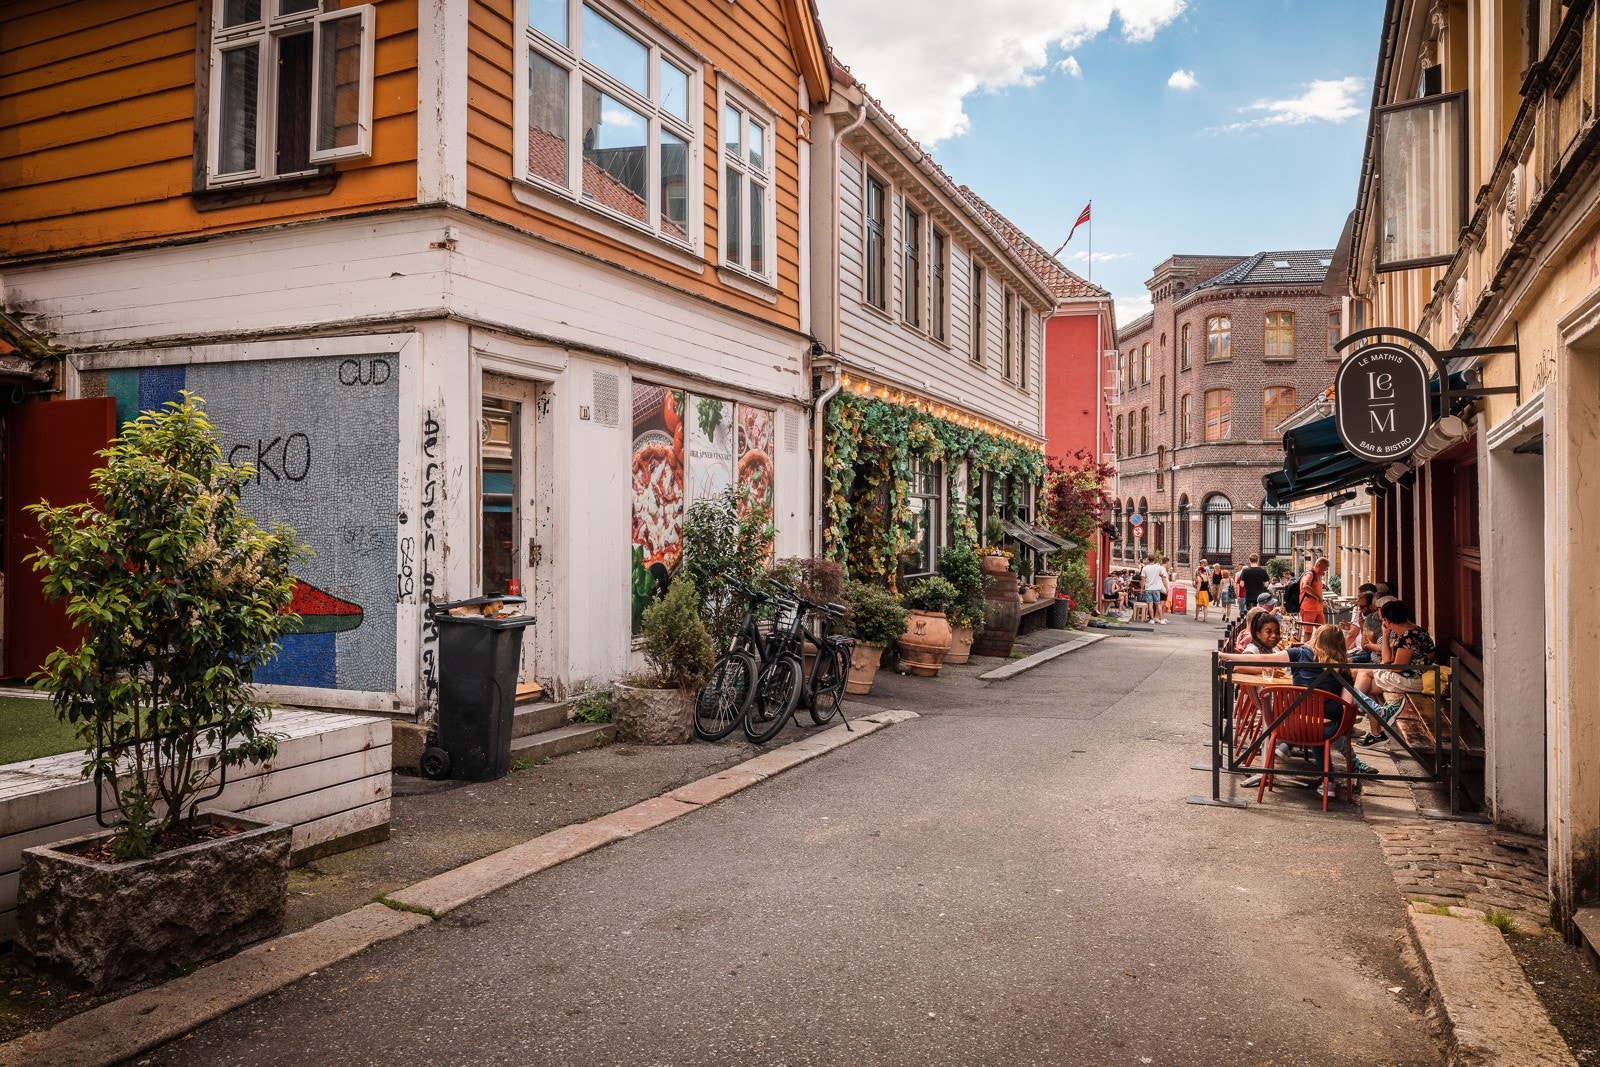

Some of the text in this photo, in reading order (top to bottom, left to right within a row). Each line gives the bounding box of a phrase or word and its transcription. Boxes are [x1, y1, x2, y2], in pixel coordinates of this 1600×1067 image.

[1358, 354, 1403, 367] LE MATHIS
[1367, 371, 1395, 400] Le
[1369, 408, 1397, 434] M
[1359, 441, 1375, 452] BAR
[1385, 437, 1411, 452] BISTRO
